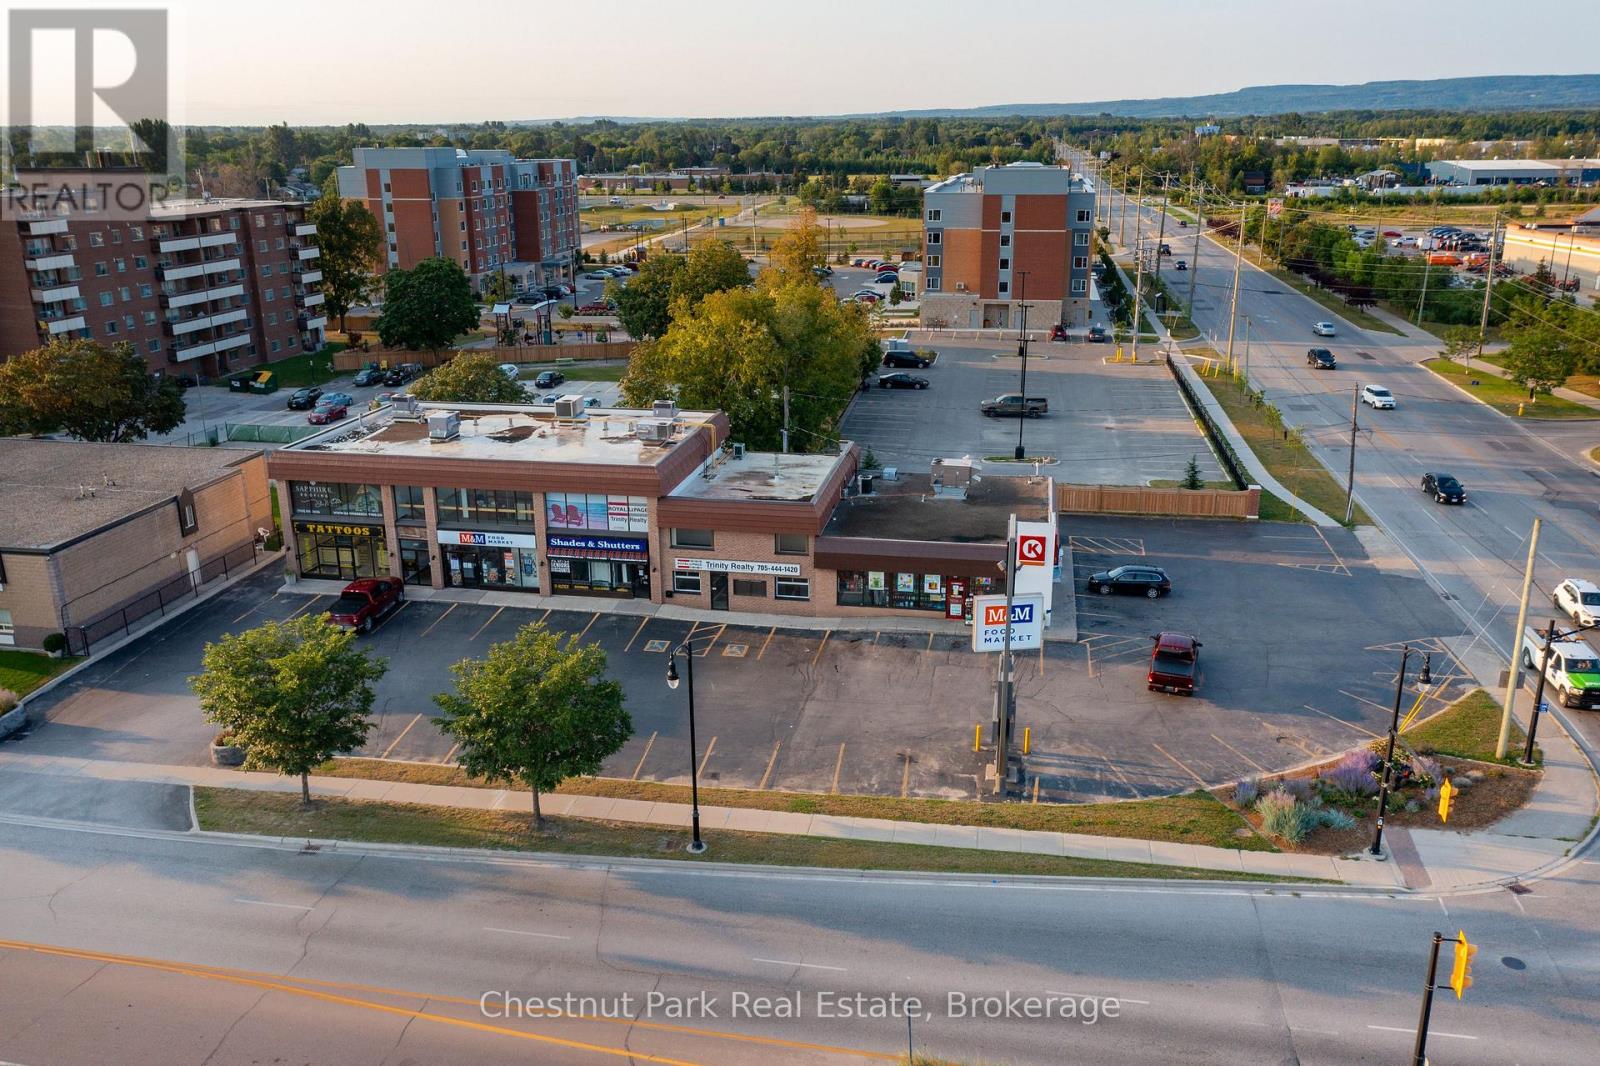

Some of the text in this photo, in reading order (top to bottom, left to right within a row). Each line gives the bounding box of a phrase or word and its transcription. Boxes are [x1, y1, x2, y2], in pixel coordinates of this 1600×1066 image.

[306, 524, 369, 535] TATTOOS
[461, 535, 484, 544] M&M
[551, 538, 585, 546] Shades
[597, 541, 640, 550] Shutters
[706, 562, 729, 570] Trinity
[731, 563, 755, 572] Realty
[757, 565, 798, 573] 705-444-1420
